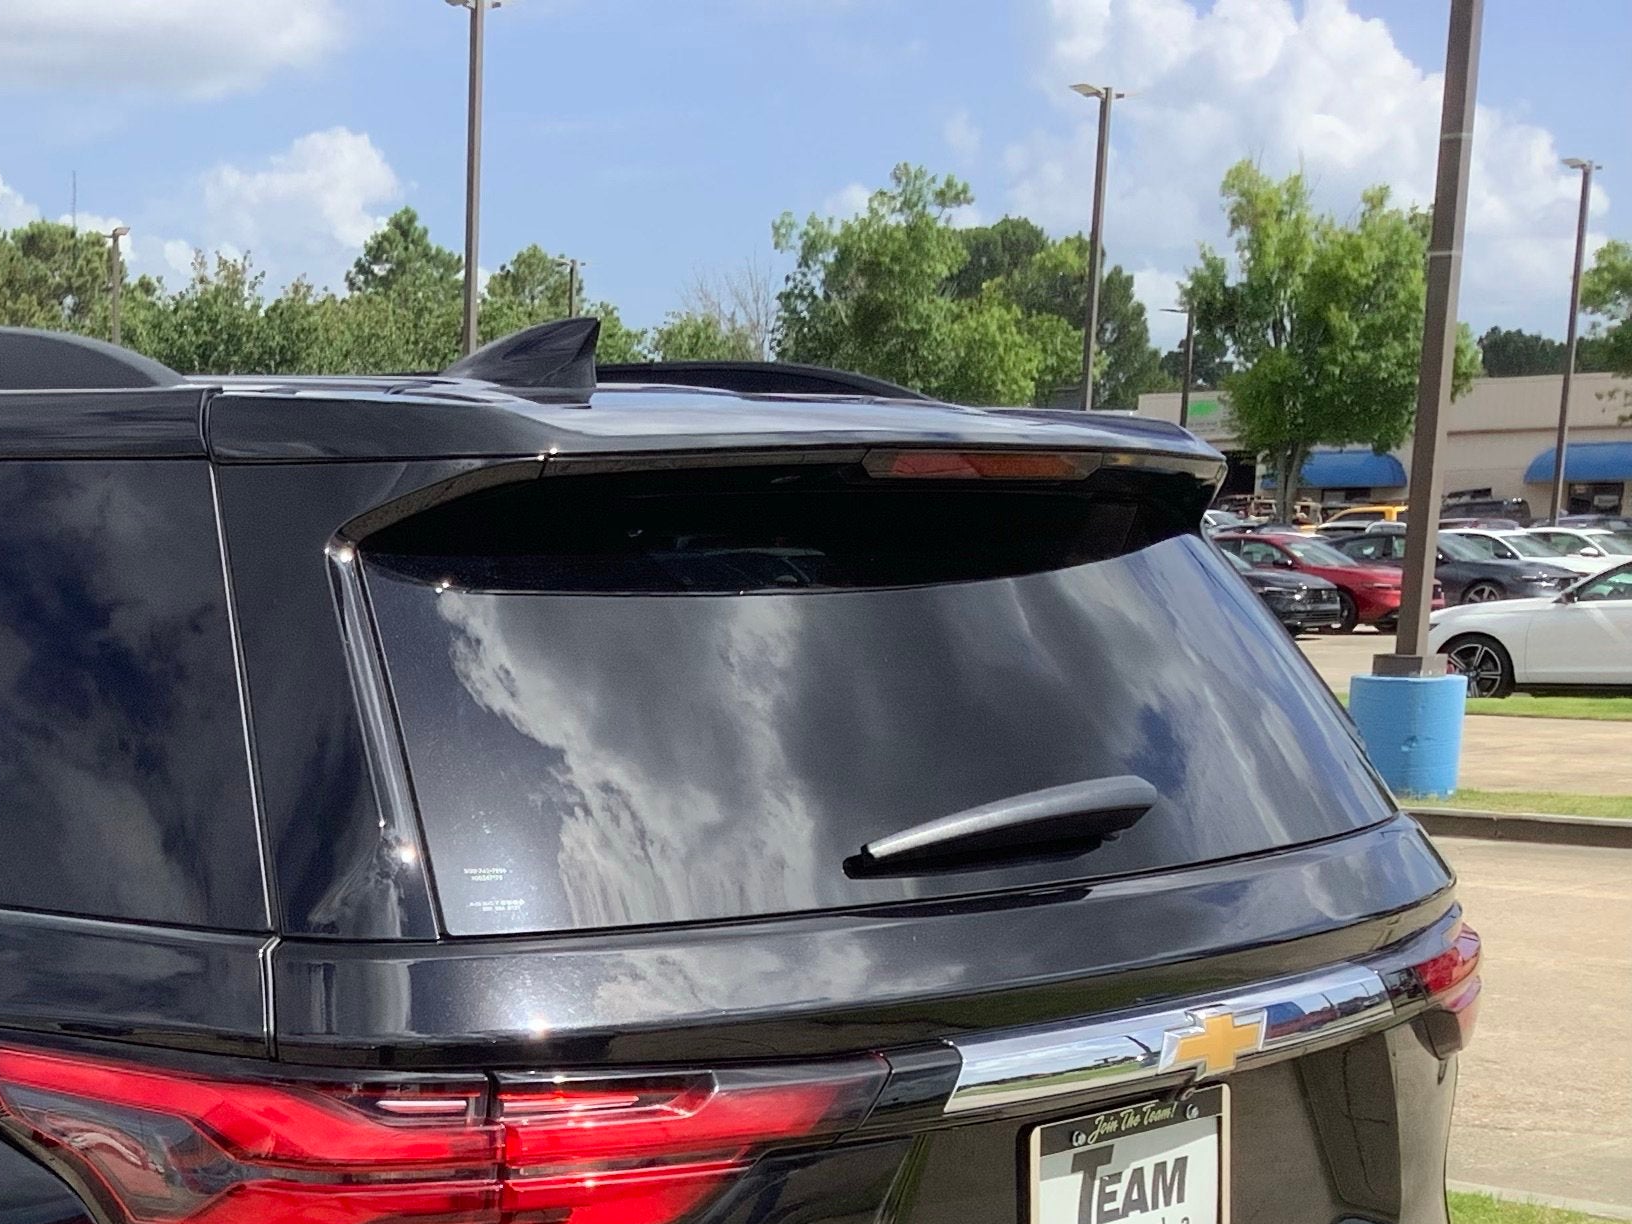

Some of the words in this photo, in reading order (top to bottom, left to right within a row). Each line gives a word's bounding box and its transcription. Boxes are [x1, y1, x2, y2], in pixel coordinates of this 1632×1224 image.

[1087, 1115, 1118, 1144] Join
[1120, 1108, 1141, 1131] The
[1142, 1101, 1178, 1126] Team!
